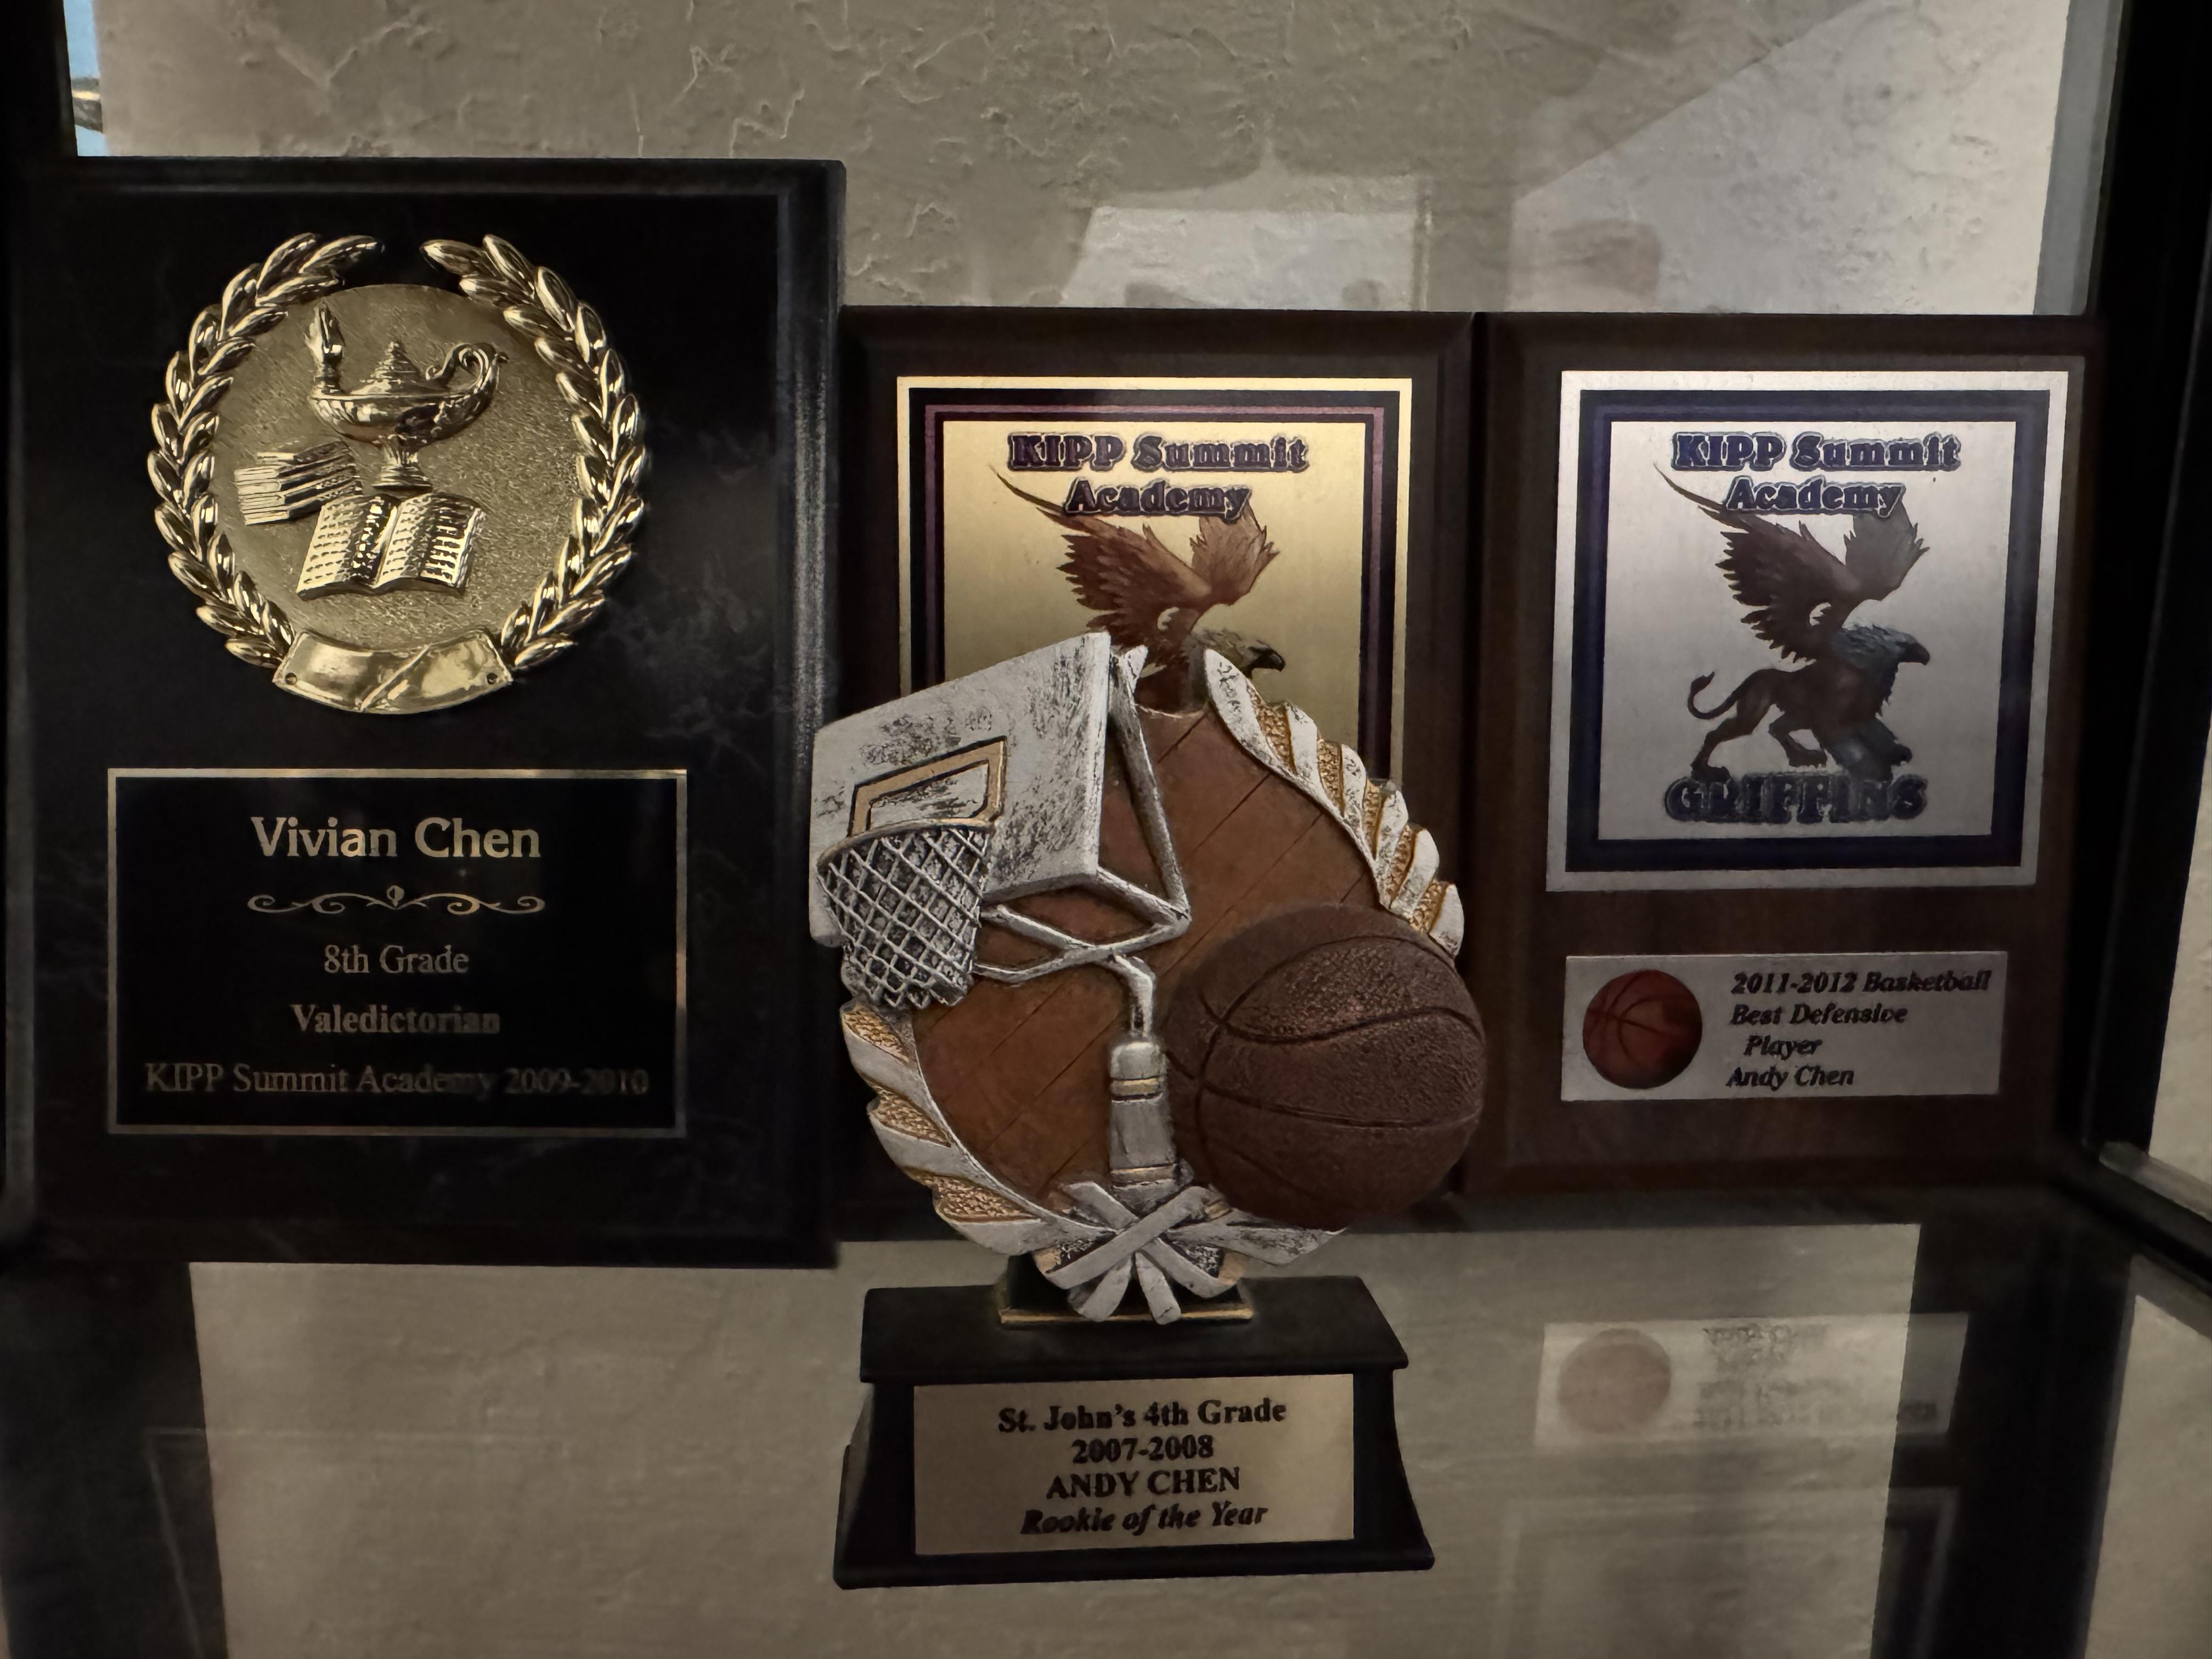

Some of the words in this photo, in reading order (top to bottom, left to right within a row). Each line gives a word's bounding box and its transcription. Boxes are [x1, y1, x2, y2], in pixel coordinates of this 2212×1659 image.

[1008, 432, 1126, 472] KIPP
[1131, 432, 1310, 473] Summit
[1671, 431, 1787, 471] KIPP
[1790, 432, 1961, 472] Summit
[1063, 477, 1252, 523] Academy
[1724, 475, 1906, 518] Academy
[251, 816, 398, 859] Vivian
[414, 817, 541, 859] Chen
[323, 944, 370, 974] 8th
[379, 944, 470, 974] Grade
[1730, 970, 1858, 995] 2011-2012
[1862, 969, 1993, 993] Basketball
[290, 1003, 500, 1035] Valedictorian
[1729, 1003, 1785, 1026] Best
[1789, 1002, 1909, 1025] Defensive
[1743, 1034, 1823, 1061] Player
[145, 1062, 224, 1093] KIPP
[232, 1062, 351, 1094] Summit
[357, 1064, 494, 1100] Academy
[504, 1066, 650, 1096] 2009-2010
[1725, 1066, 1789, 1092] Andy
[1794, 1065, 1855, 1086] Chen
[998, 1408, 1036, 1434] St.
[1043, 1403, 1137, 1431] John's
[1143, 1401, 1189, 1427] 4th
[1197, 1397, 1287, 1425] Grade
[1071, 1435, 1215, 1464] 2007-2008
[1045, 1470, 1139, 1500] ANDY
[1147, 1466, 1240, 1496] CHEN
[1019, 1508, 1117, 1536] Rookie
[1122, 1504, 1156, 1537] of
[1159, 1503, 1201, 1529] the
[1211, 1500, 1269, 1528] Year
